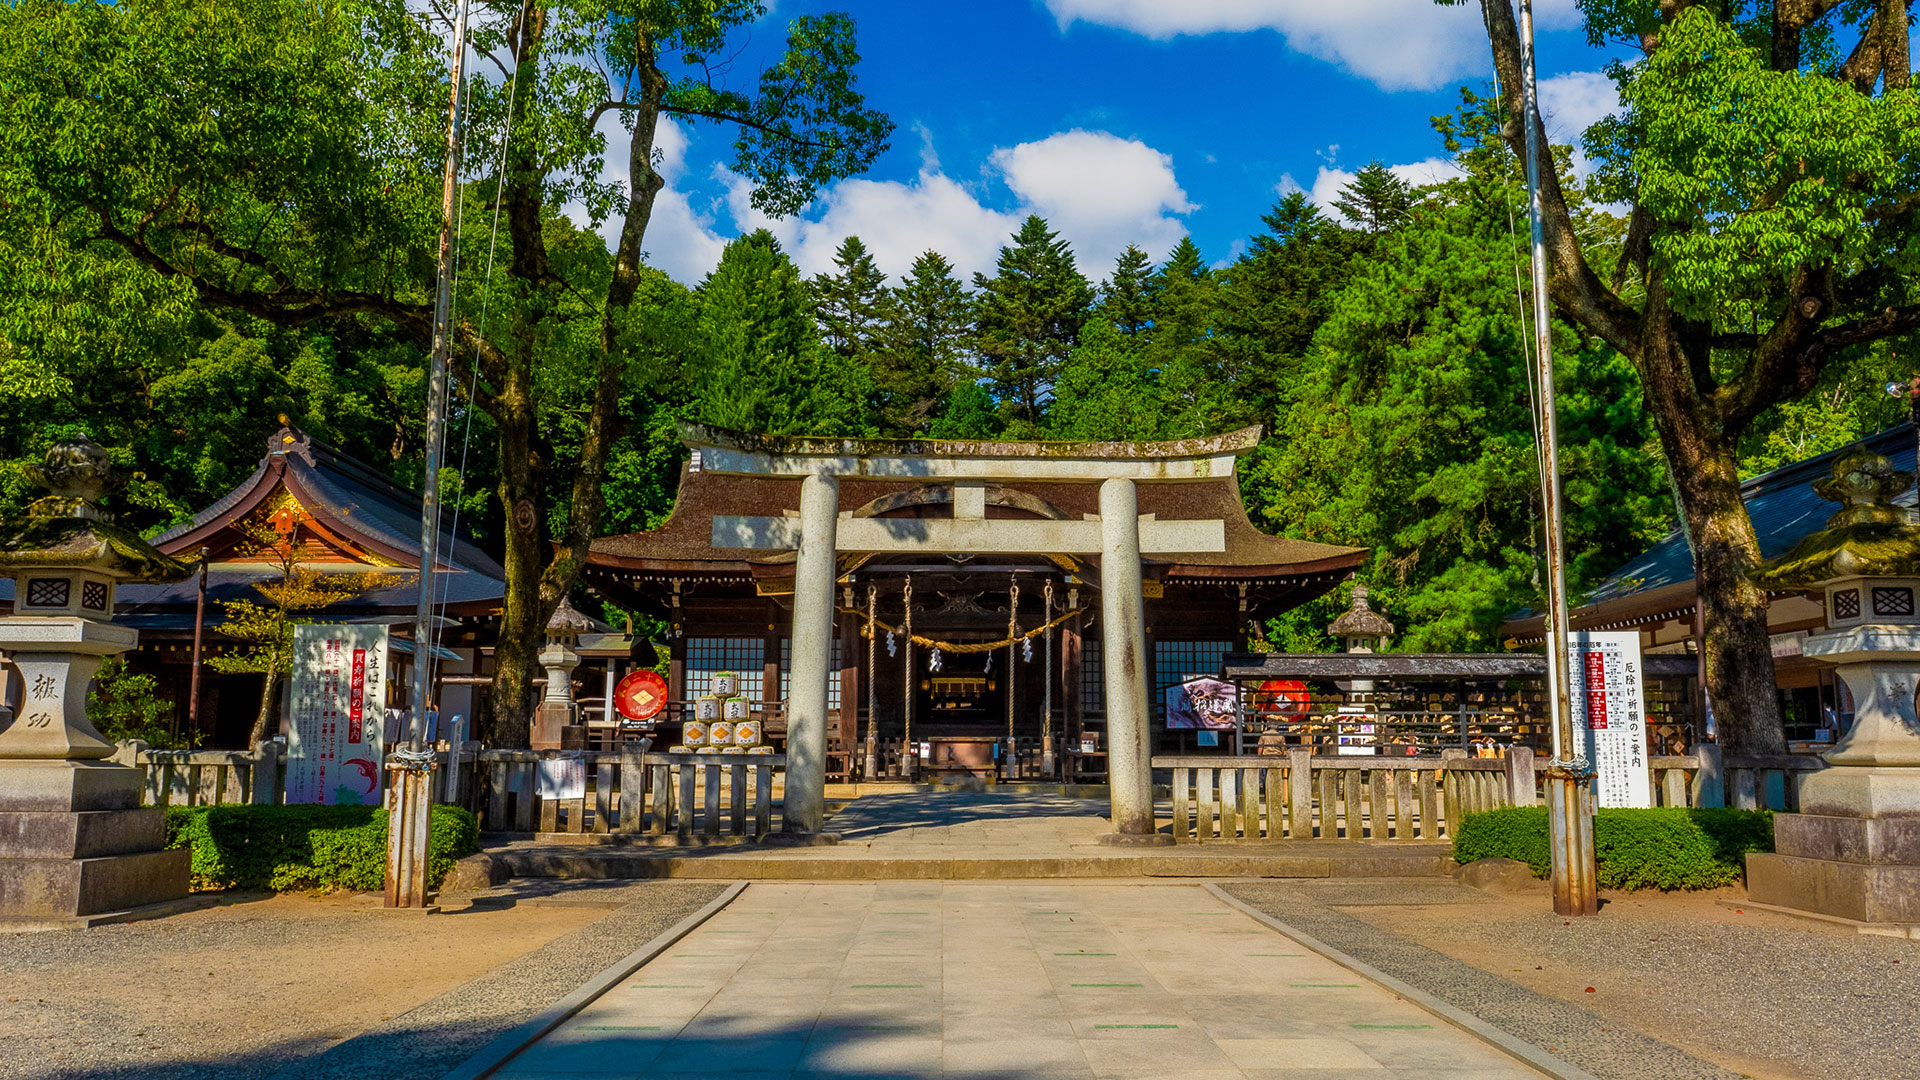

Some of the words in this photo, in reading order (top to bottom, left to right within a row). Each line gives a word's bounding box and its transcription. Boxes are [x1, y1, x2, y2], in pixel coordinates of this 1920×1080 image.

[1625, 662, 1641, 767] 厄除け祈願のご案内
